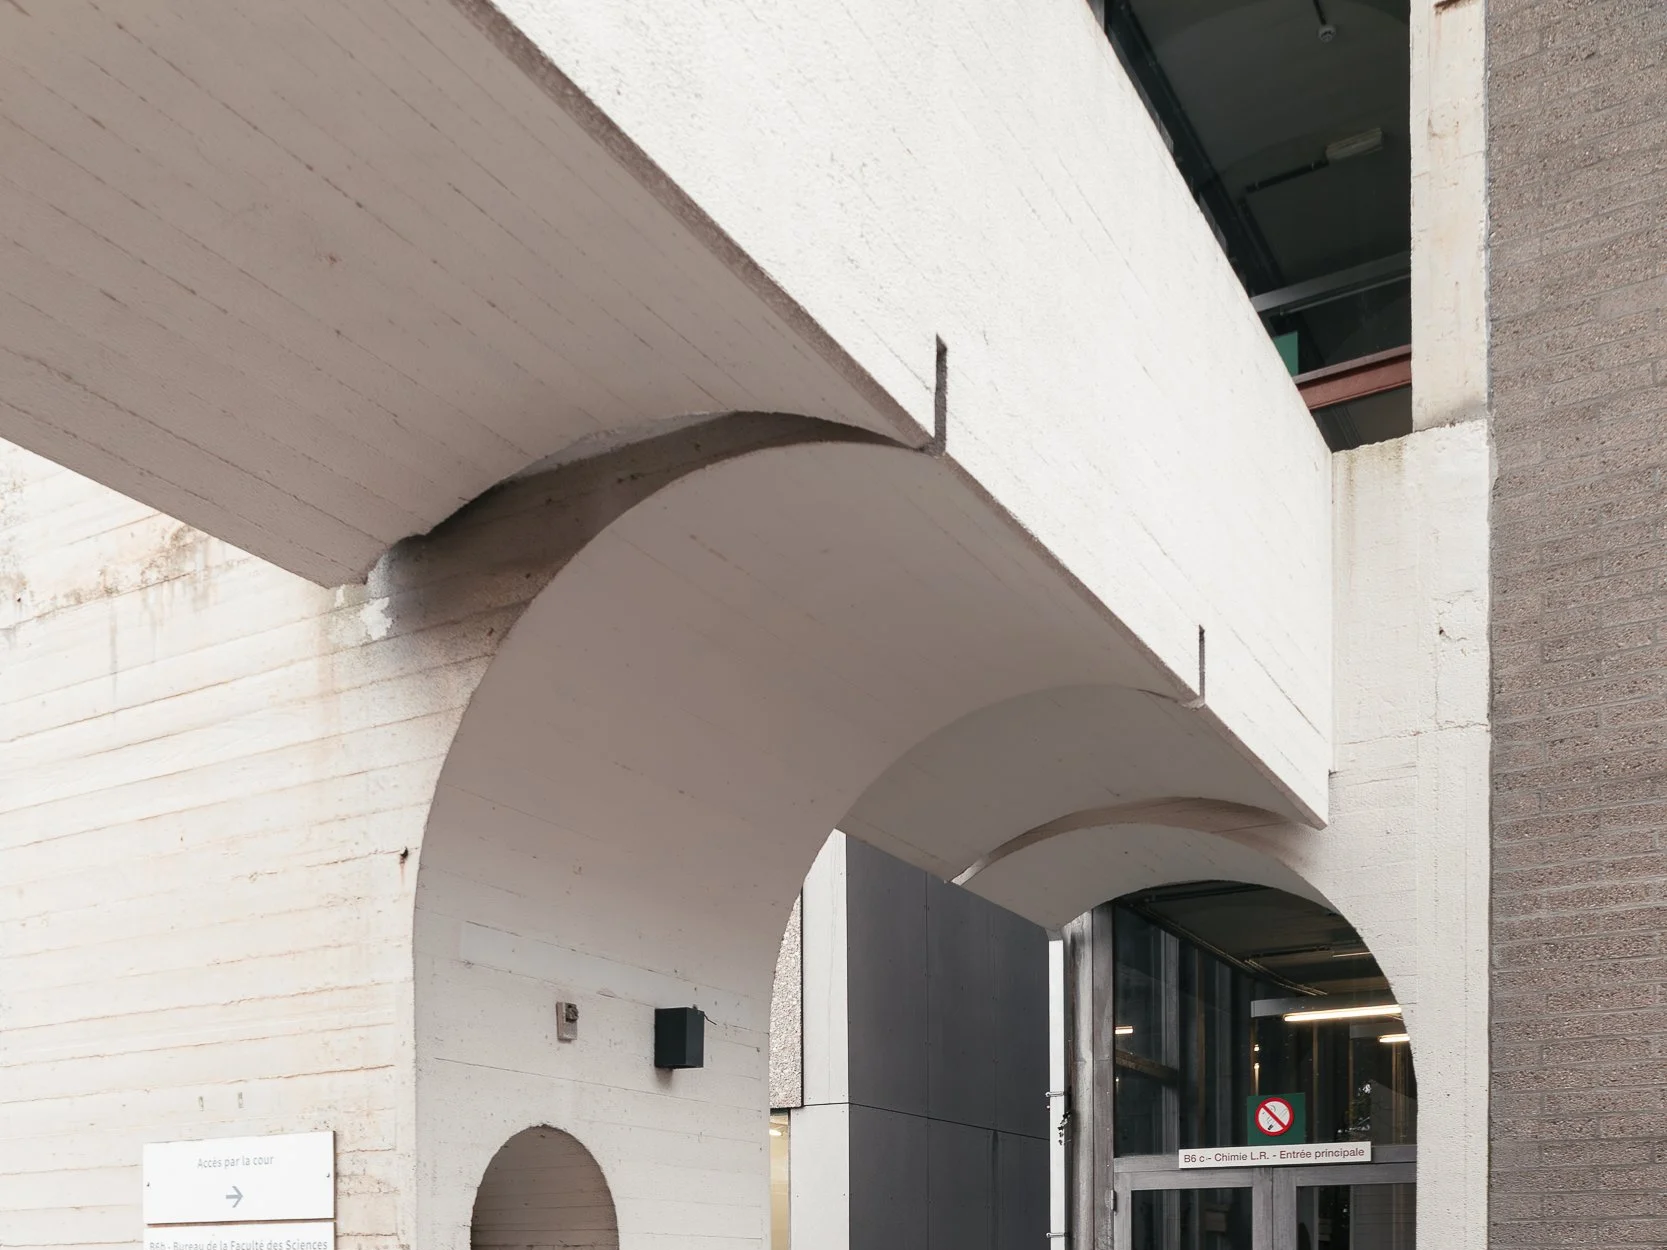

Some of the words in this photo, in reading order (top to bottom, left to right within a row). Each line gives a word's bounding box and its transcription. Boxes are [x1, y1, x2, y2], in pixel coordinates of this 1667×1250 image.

[224, 1156, 239, 1169] par
[242, 1155, 251, 1167] la
[252, 1155, 274, 1166] cour
[1184, 1154, 1196, 1163] B6
[1214, 1152, 1247, 1162] Chimie
[1250, 1151, 1270, 1161] L.R.
[1280, 1149, 1312, 1159] Entrée
[1315, 1147, 1365, 1160] principale
[220, 1240, 227, 1250] la
[230, 1239, 264, 1250] Faculté
[266, 1240, 283, 1250] des
[286, 1238, 328, 1250] Sciences
